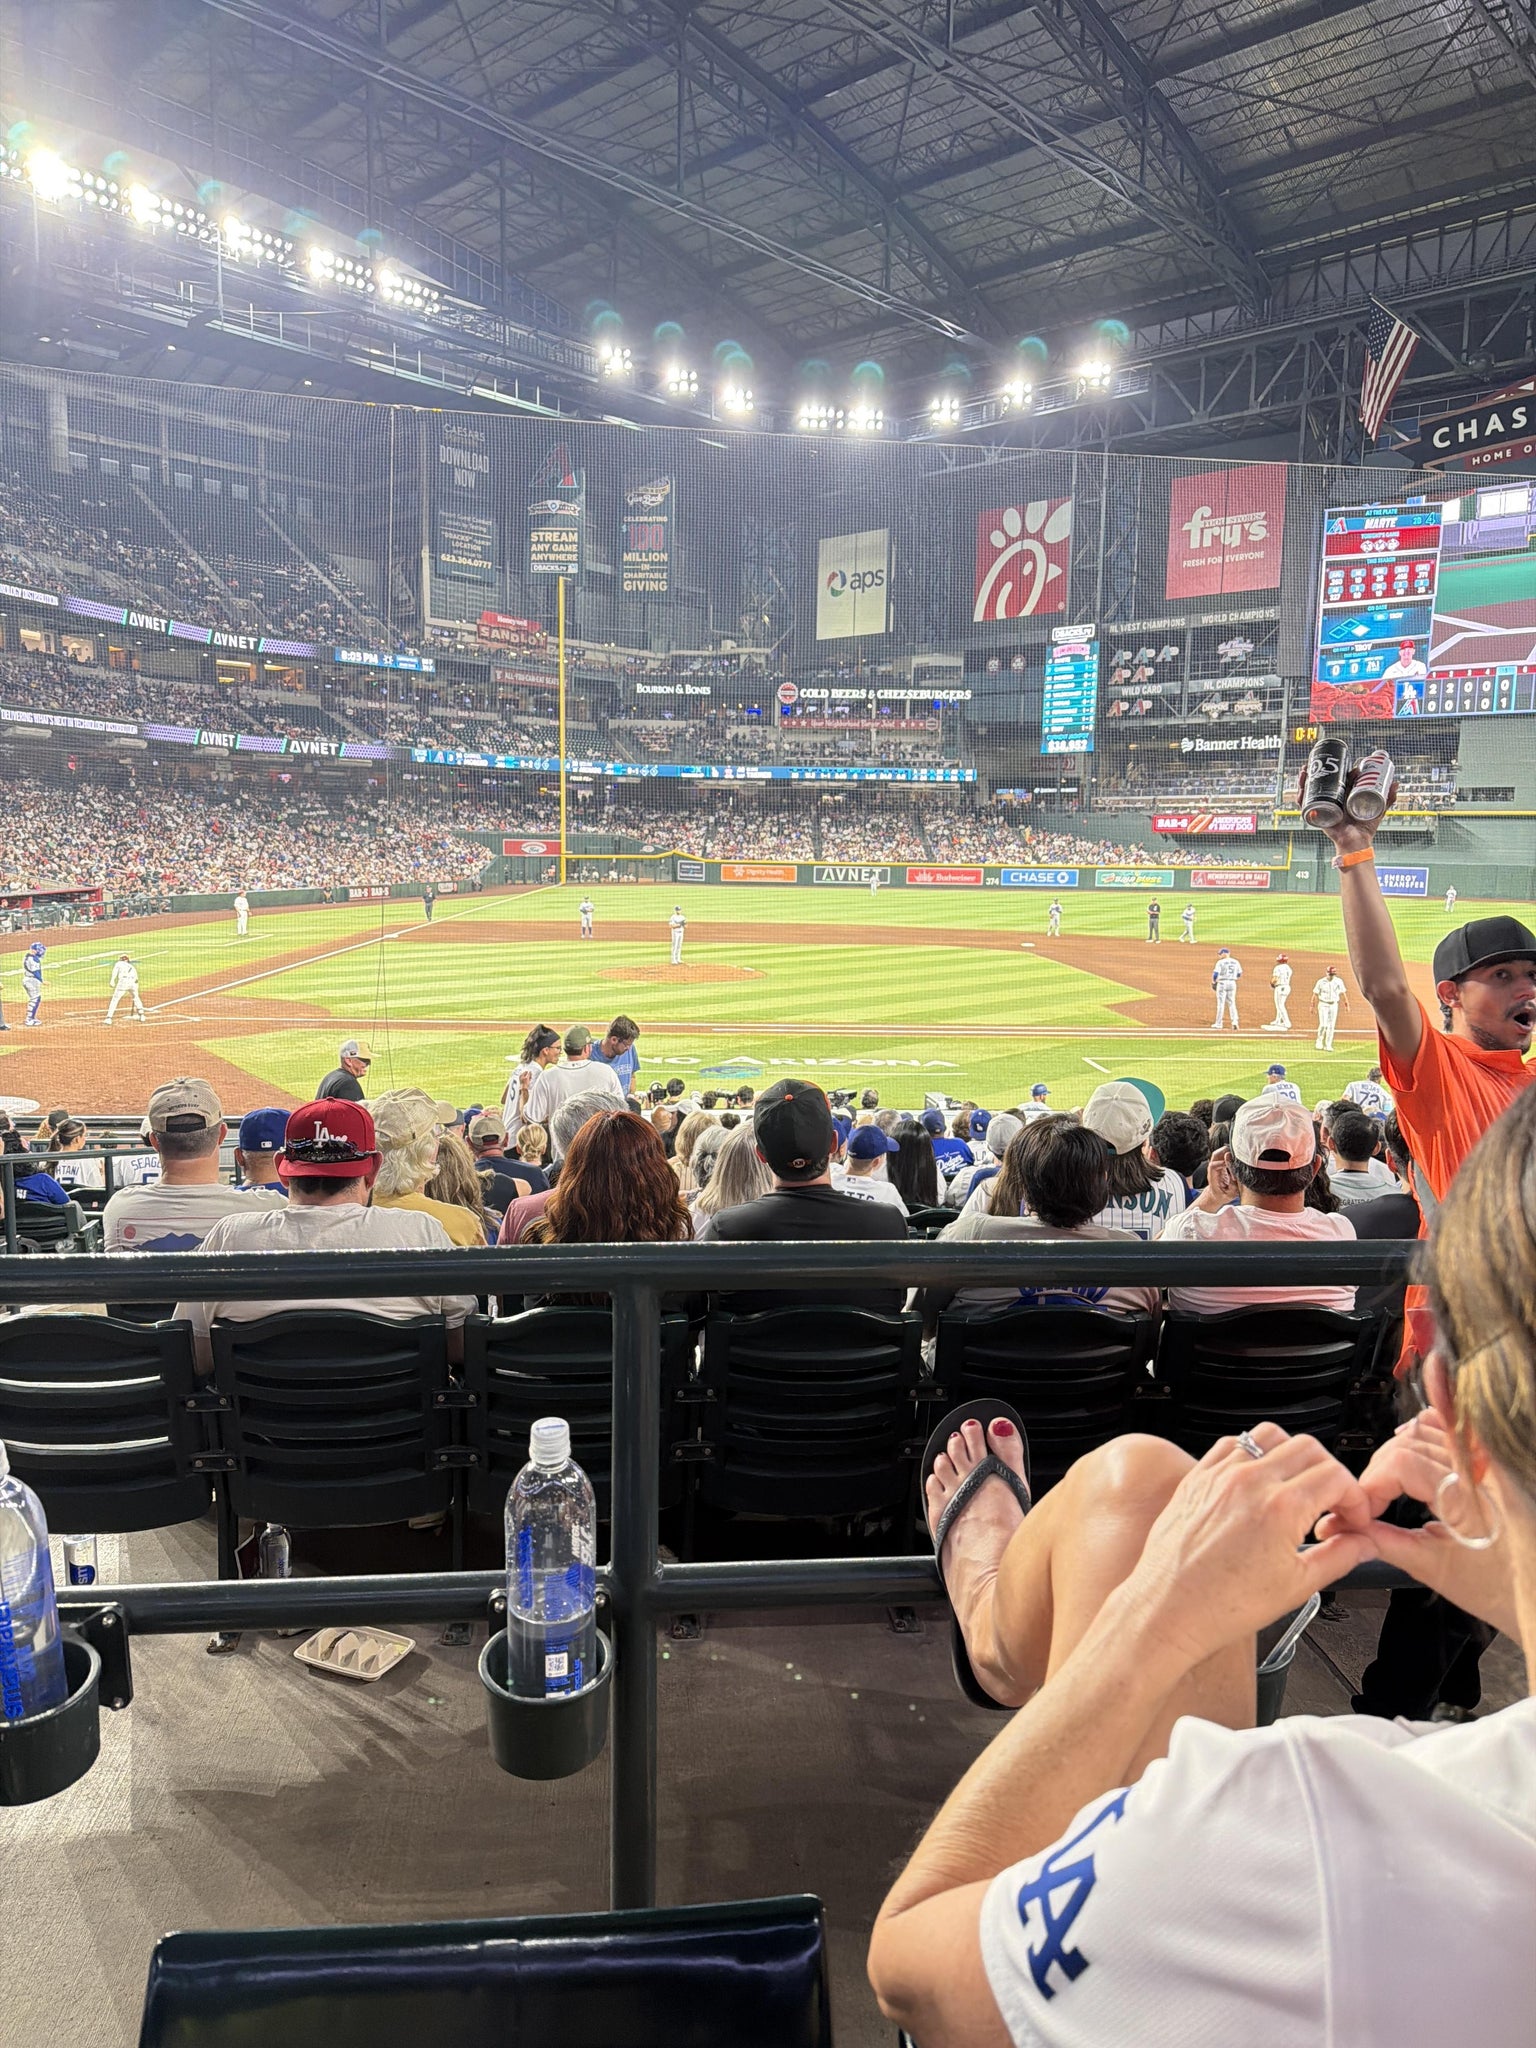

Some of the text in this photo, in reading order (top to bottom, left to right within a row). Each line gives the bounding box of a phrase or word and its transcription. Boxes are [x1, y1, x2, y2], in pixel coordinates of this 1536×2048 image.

[1433, 407, 1536, 448] CHAS
[440, 445, 489, 473] DOWNLOAD
[1472, 445, 1536, 465] HOME O
[455, 467, 476, 488] NOW
[1182, 506, 1267, 549] fry's
[1364, 517, 1398, 529] MARTE
[530, 532, 578, 542] STREAM
[452, 541, 482, 552] LOCATION
[530, 544, 578, 552] ANY GAME
[440, 554, 492, 569] 623.304.0777
[623, 553, 668, 562] MILLION
[1183, 551, 1265, 568] FRESH FOR EVERYONE
[623, 581, 668, 592] GIVING
[850, 569, 885, 594] aps
[1202, 609, 1275, 625] WORLD CHAMPIONS
[1120, 622, 1141, 633] WEST
[1143, 618, 1186, 630] CHAMPIONS
[480, 625, 547, 646] SANDLOT
[1354, 643, 1372, 652] TROY
[341, 650, 379, 665] 8:05 PM
[675, 684, 684, 695] &
[1121, 684, 1162, 697] WILD CARD
[1203, 677, 1265, 690] NL CHAMPIONS
[1428, 683, 1437, 695] 2
[1445, 682, 1455, 694] 2
[1463, 681, 1473, 693] 0
[1482, 680, 1491, 692] 0
[1500, 679, 1510, 691] 0
[800, 688, 829, 699] COLD
[831, 688, 867, 699] BEERS
[868, 689, 876, 699] &
[876, 689, 972, 702] CHEESEBURGERS
[1427, 701, 1437, 712] 0
[1444, 700, 1454, 712] 0
[1463, 699, 1471, 710] 1
[1480, 698, 1490, 710] 0
[1500, 697, 1507, 709] 1
[1, 709, 34, 723] DELIVERING
[74, 718, 105, 731] TECHNOLOGY
[289, 741, 340, 756] AVNET
[1195, 734, 1282, 751] Banner Health
[1157, 819, 1188, 828] BAR-S
[821, 868, 882, 882] AVNET
[935, 873, 976, 882] Budweiser
[985, 877, 999, 886] 374
[1010, 872, 1055, 883] CHASE
[1207, 872, 1244, 881] MEMBERSHIPS
[1253, 873, 1267, 881] SALE
[1296, 871, 1310, 879] 413
[1384, 874, 1417, 882] ENERGY
[1384, 881, 1425, 889] TRANSFER
[720, 1055, 960, 1068] ARIZONA
[1361, 1083, 1380, 1094] ROJAS
[1358, 1091, 1380, 1106] 72
[56, 1165, 80, 1176] HTANI
[1106, 1187, 1173, 1219] NSON
[1017, 1787, 1132, 2001] LA
